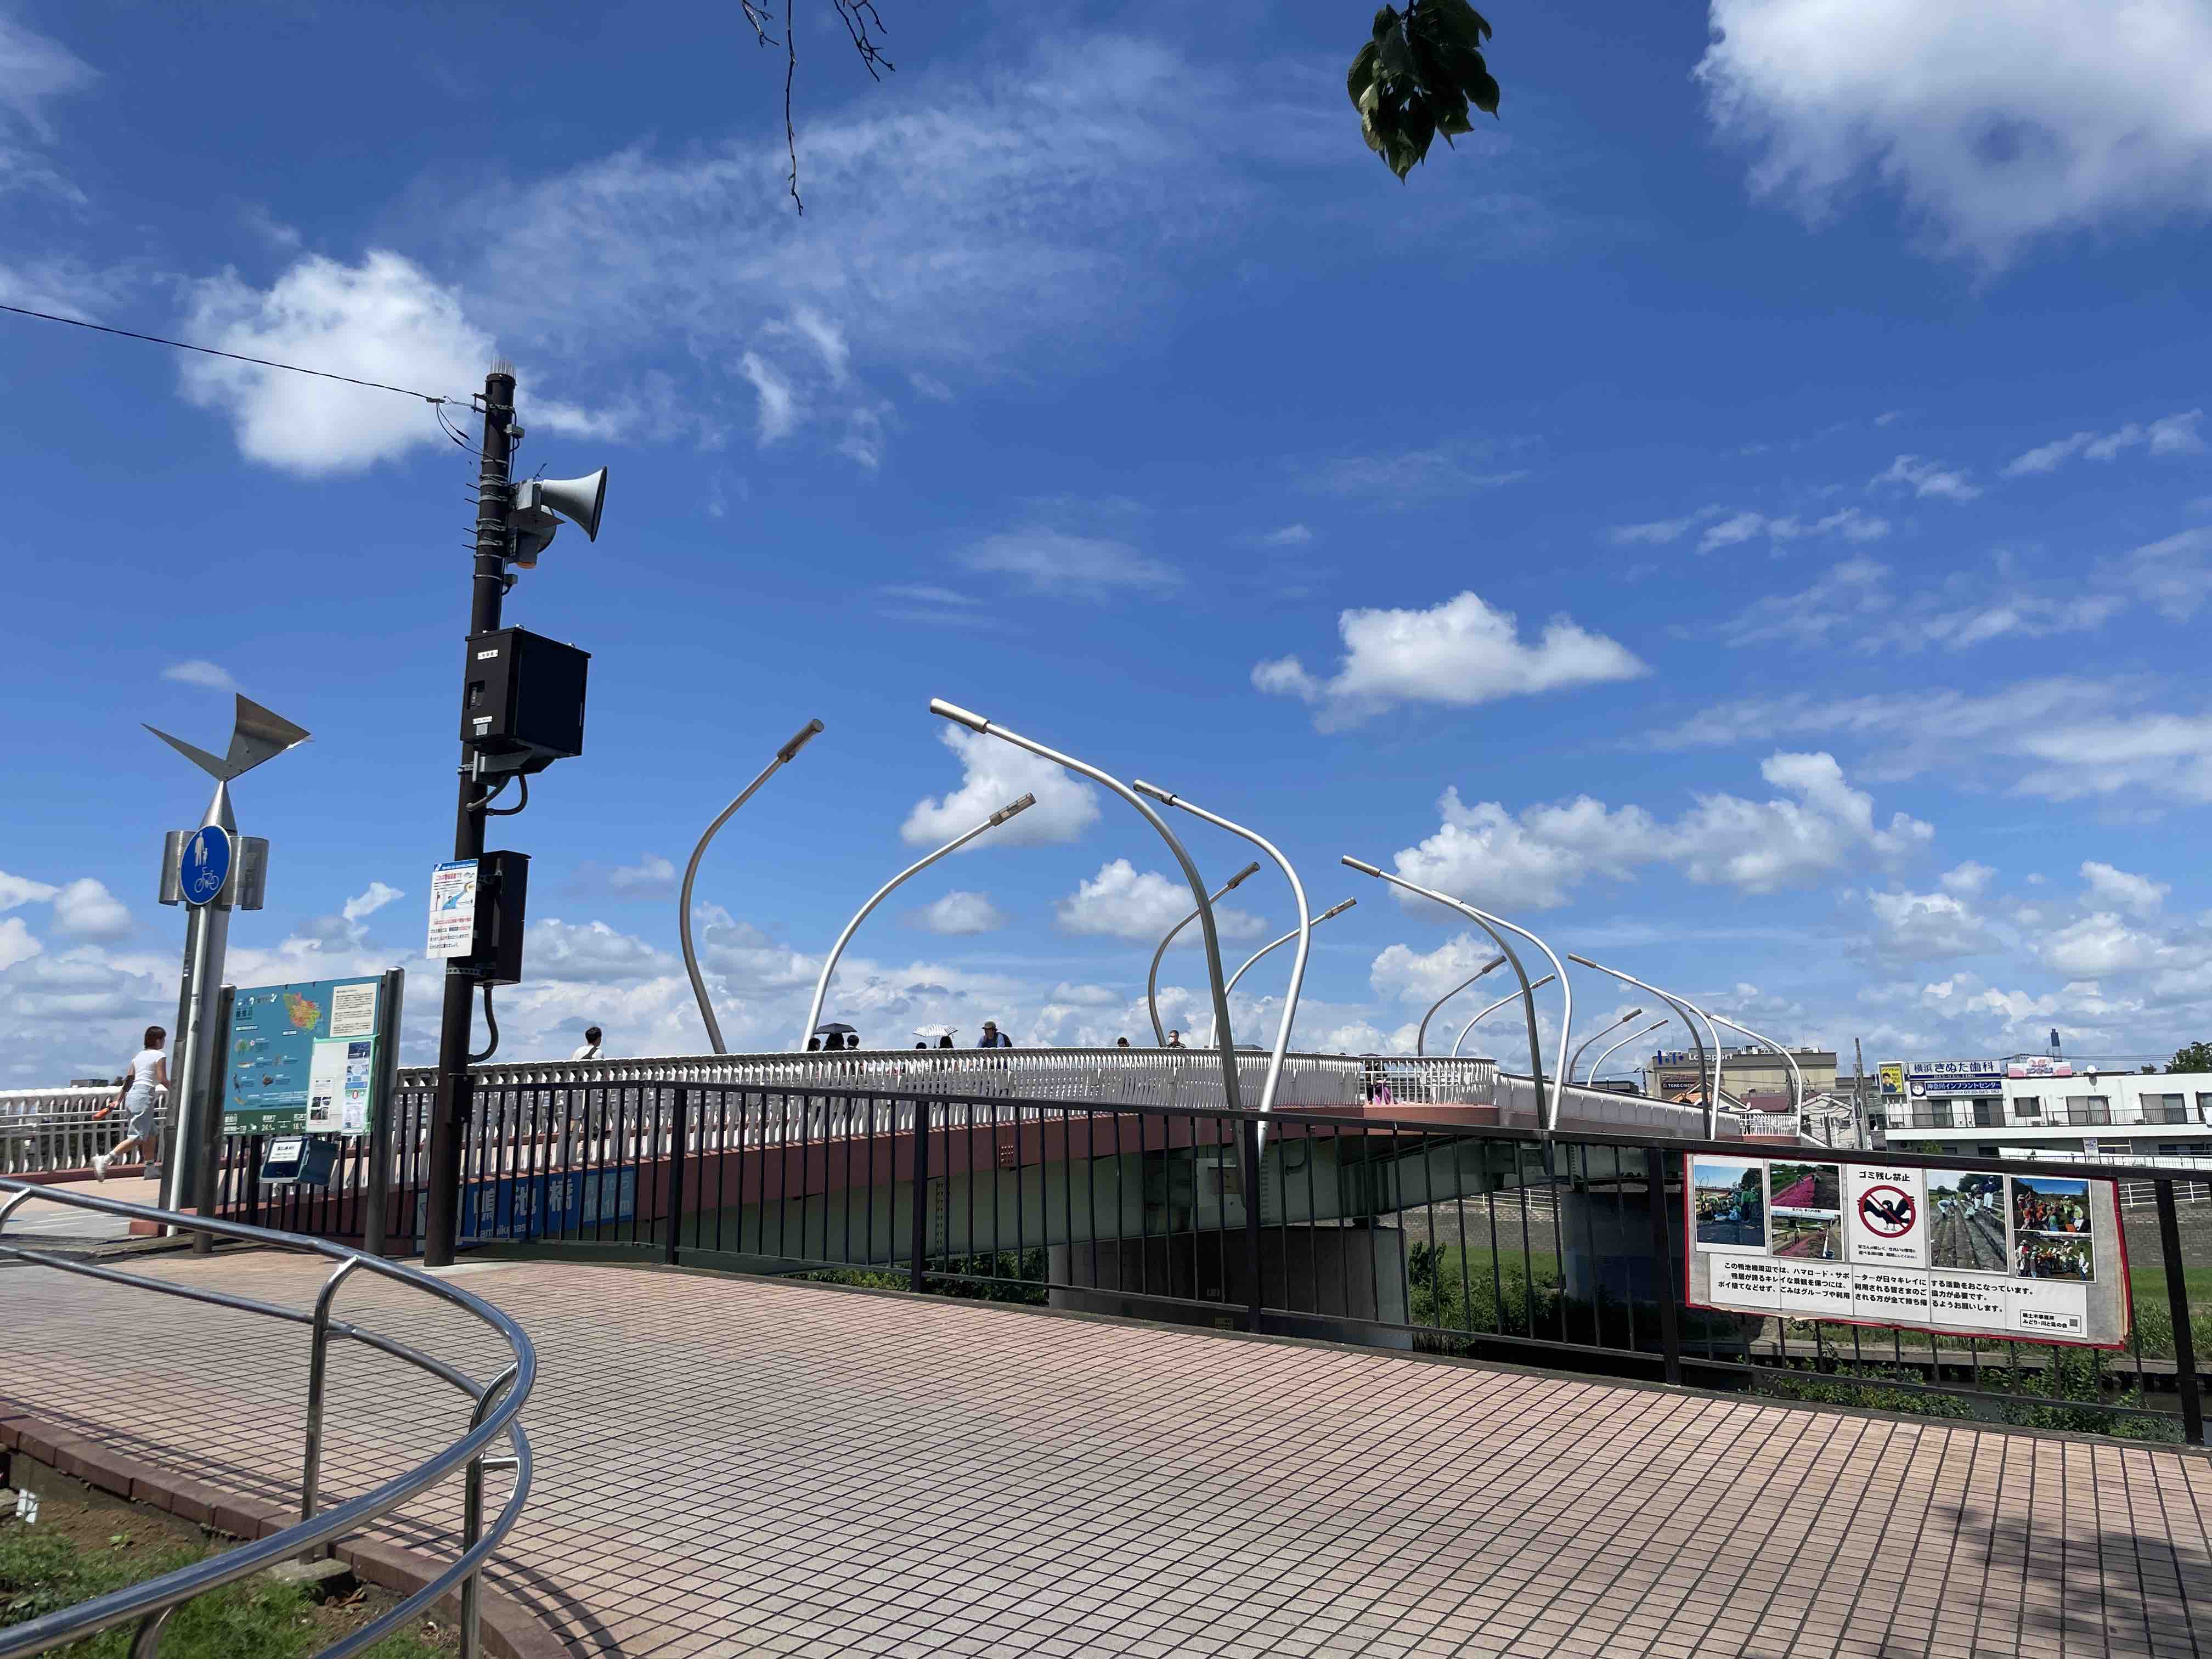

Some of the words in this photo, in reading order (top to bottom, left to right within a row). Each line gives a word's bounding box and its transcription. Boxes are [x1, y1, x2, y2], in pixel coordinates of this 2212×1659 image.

[1859, 1171, 1910, 1182] ゴミ残し禁止
